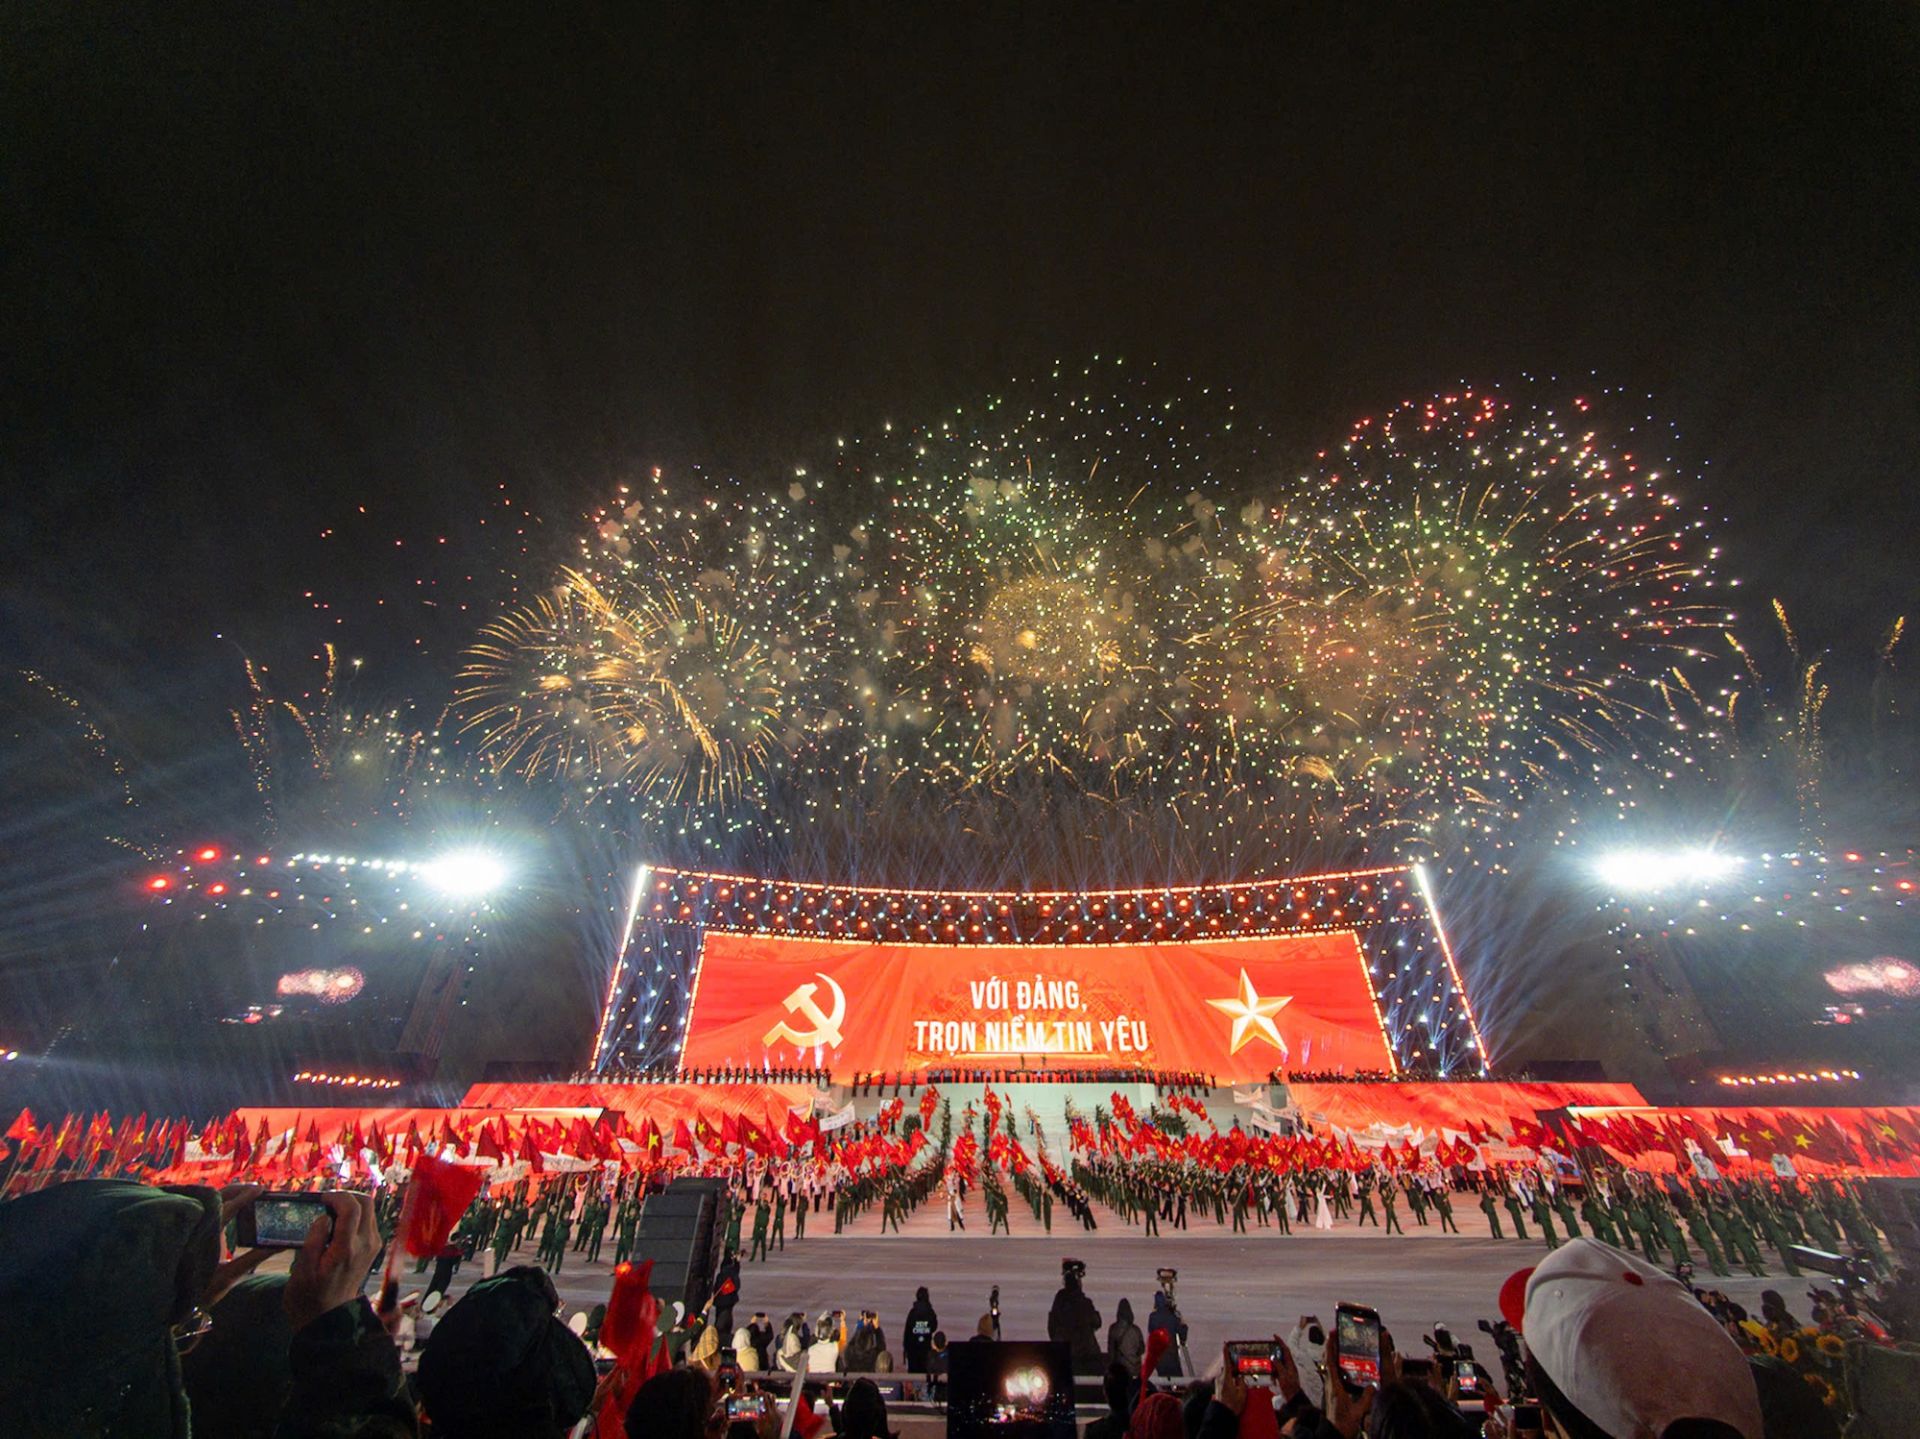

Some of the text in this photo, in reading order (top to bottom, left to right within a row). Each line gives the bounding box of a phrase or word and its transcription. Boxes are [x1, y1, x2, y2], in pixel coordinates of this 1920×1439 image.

[970, 974, 1087, 1012] VỚI ĐẢNG,
[914, 1014, 1148, 1056] TRỌN NIỀM TIN YÊU
